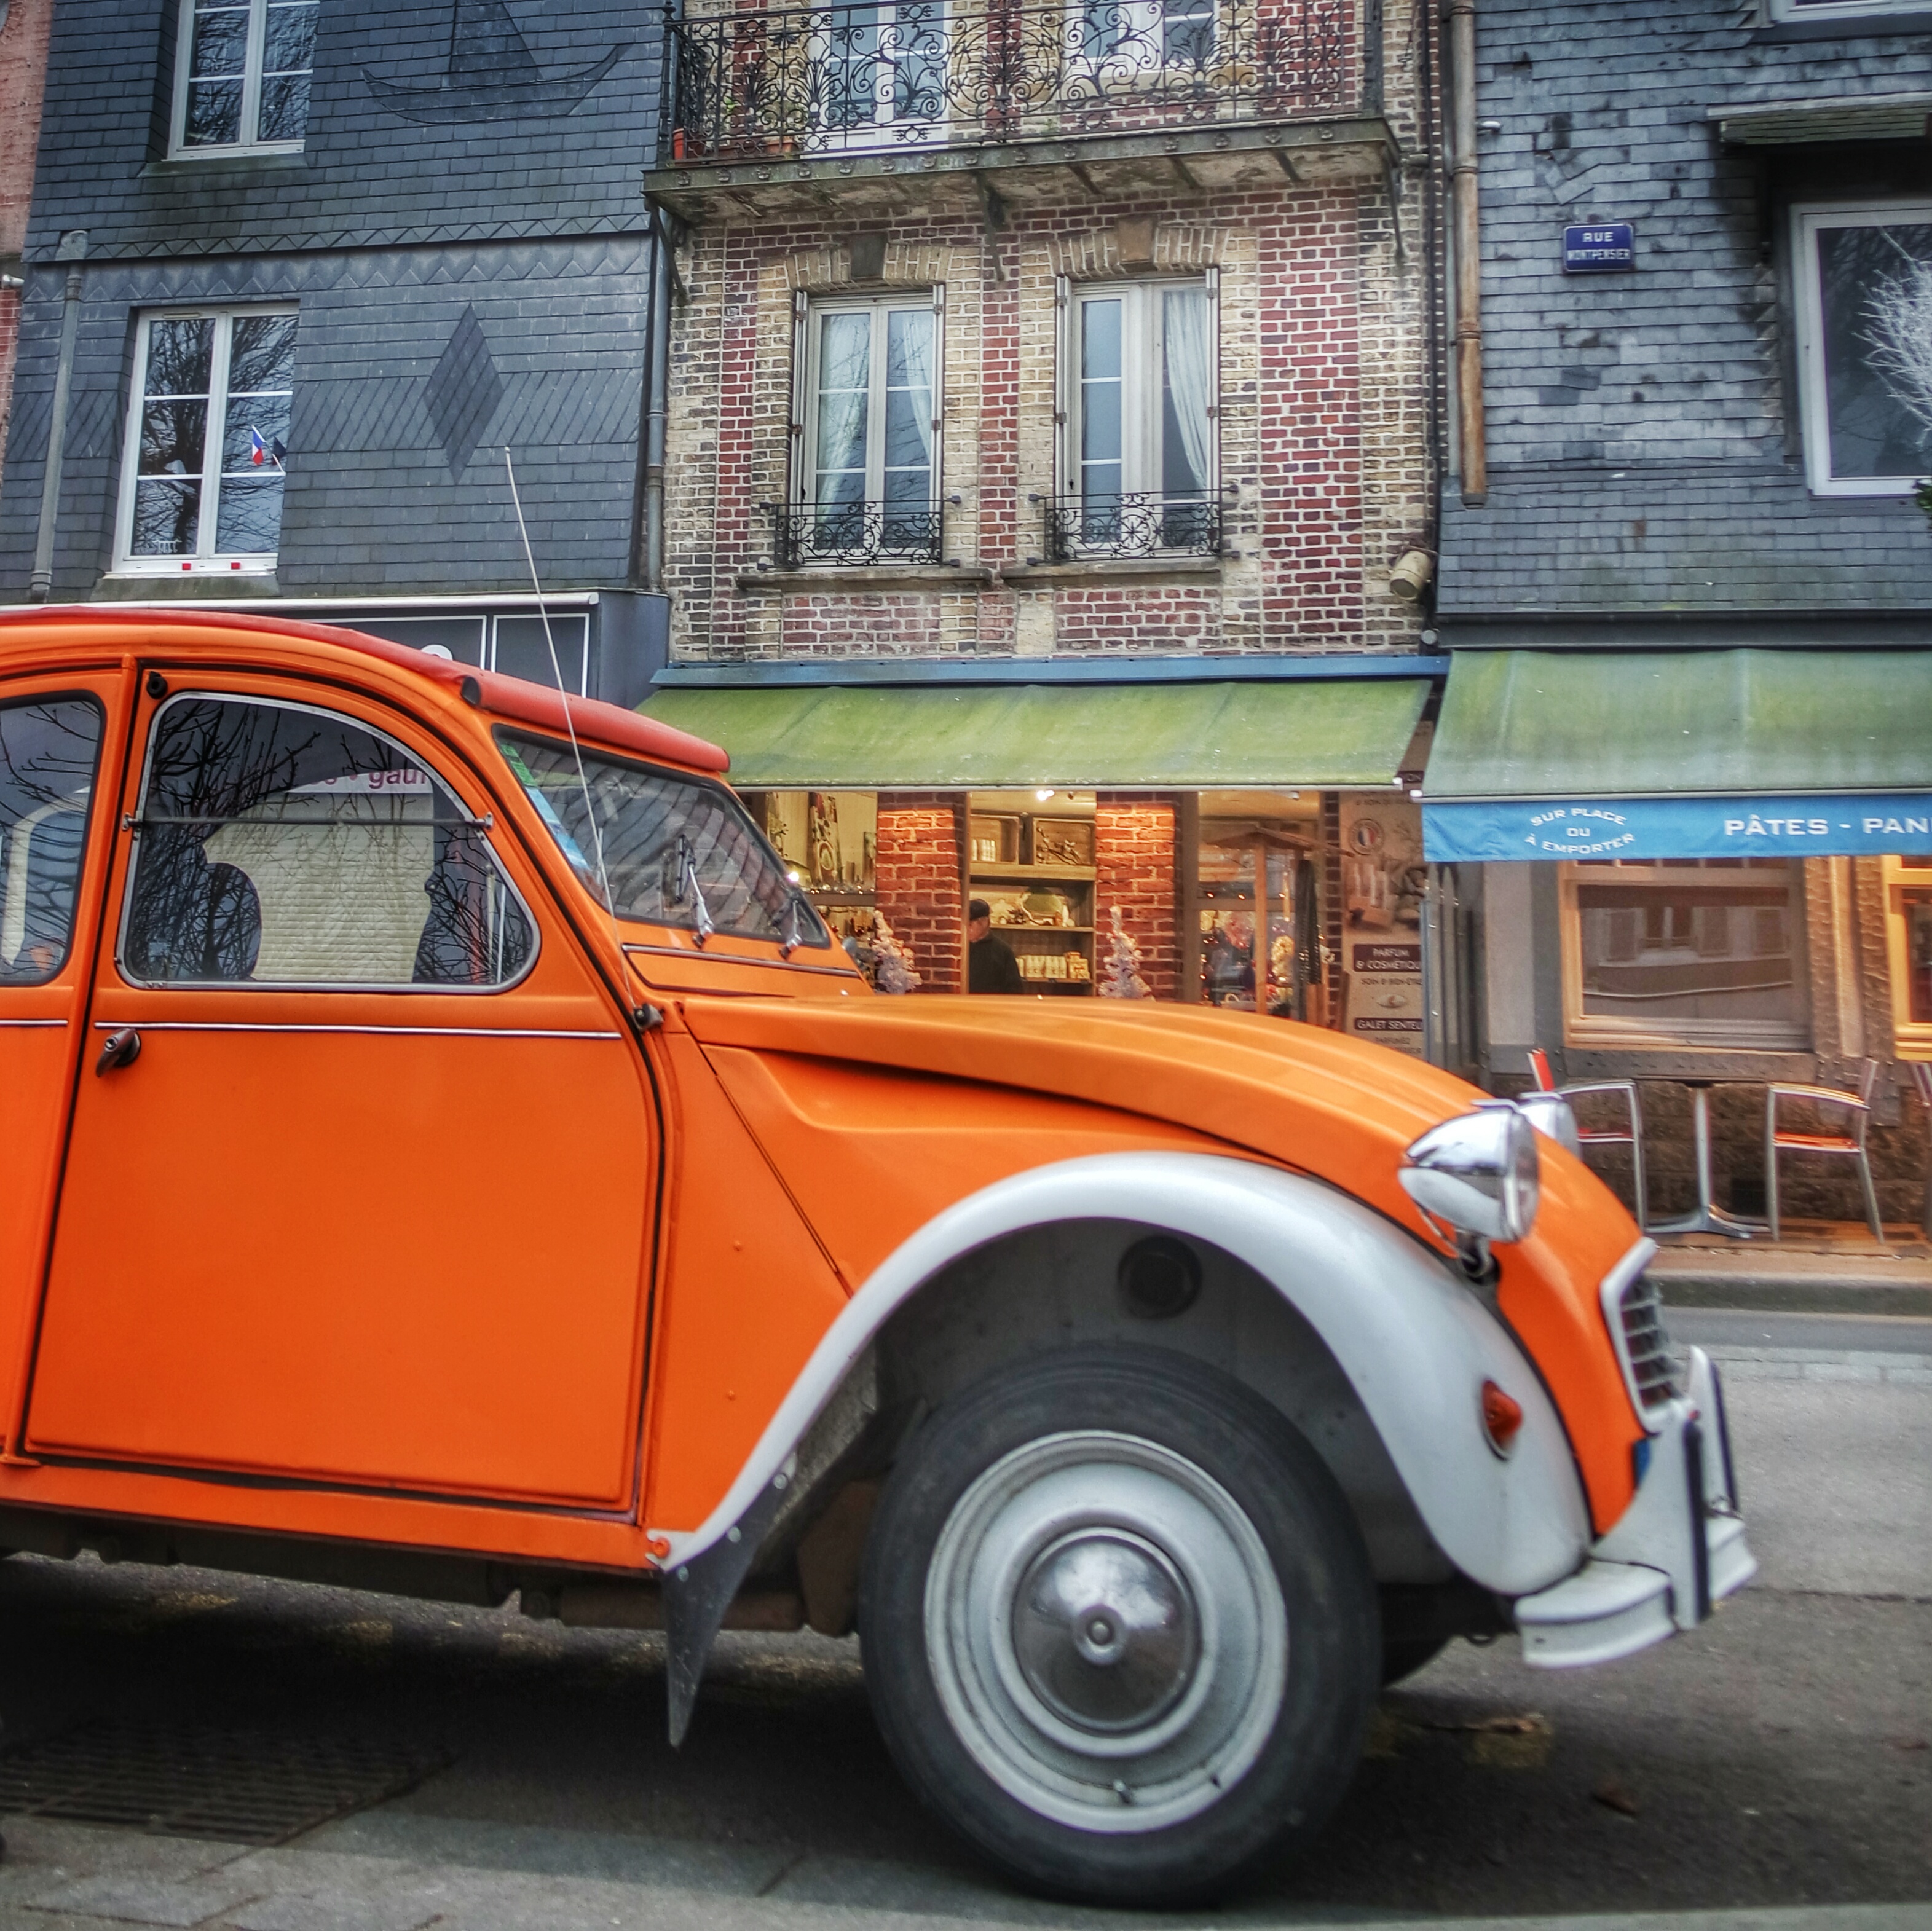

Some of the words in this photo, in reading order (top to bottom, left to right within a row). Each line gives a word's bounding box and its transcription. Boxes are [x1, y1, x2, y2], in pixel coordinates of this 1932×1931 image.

[1582, 232, 1614, 242] RUE
[1530, 809, 1566, 826] SUR
[1571, 808, 1627, 825] PLACE
[1724, 814, 1828, 836] PÂTES
[1862, 817, 1932, 834] PAN
[1567, 828, 1590, 837] OU
[1541, 833, 1635, 854] EMPORTER
[1373, 948, 1410, 957] PARFUM
[1357, 1020, 1386, 1029] GALET
